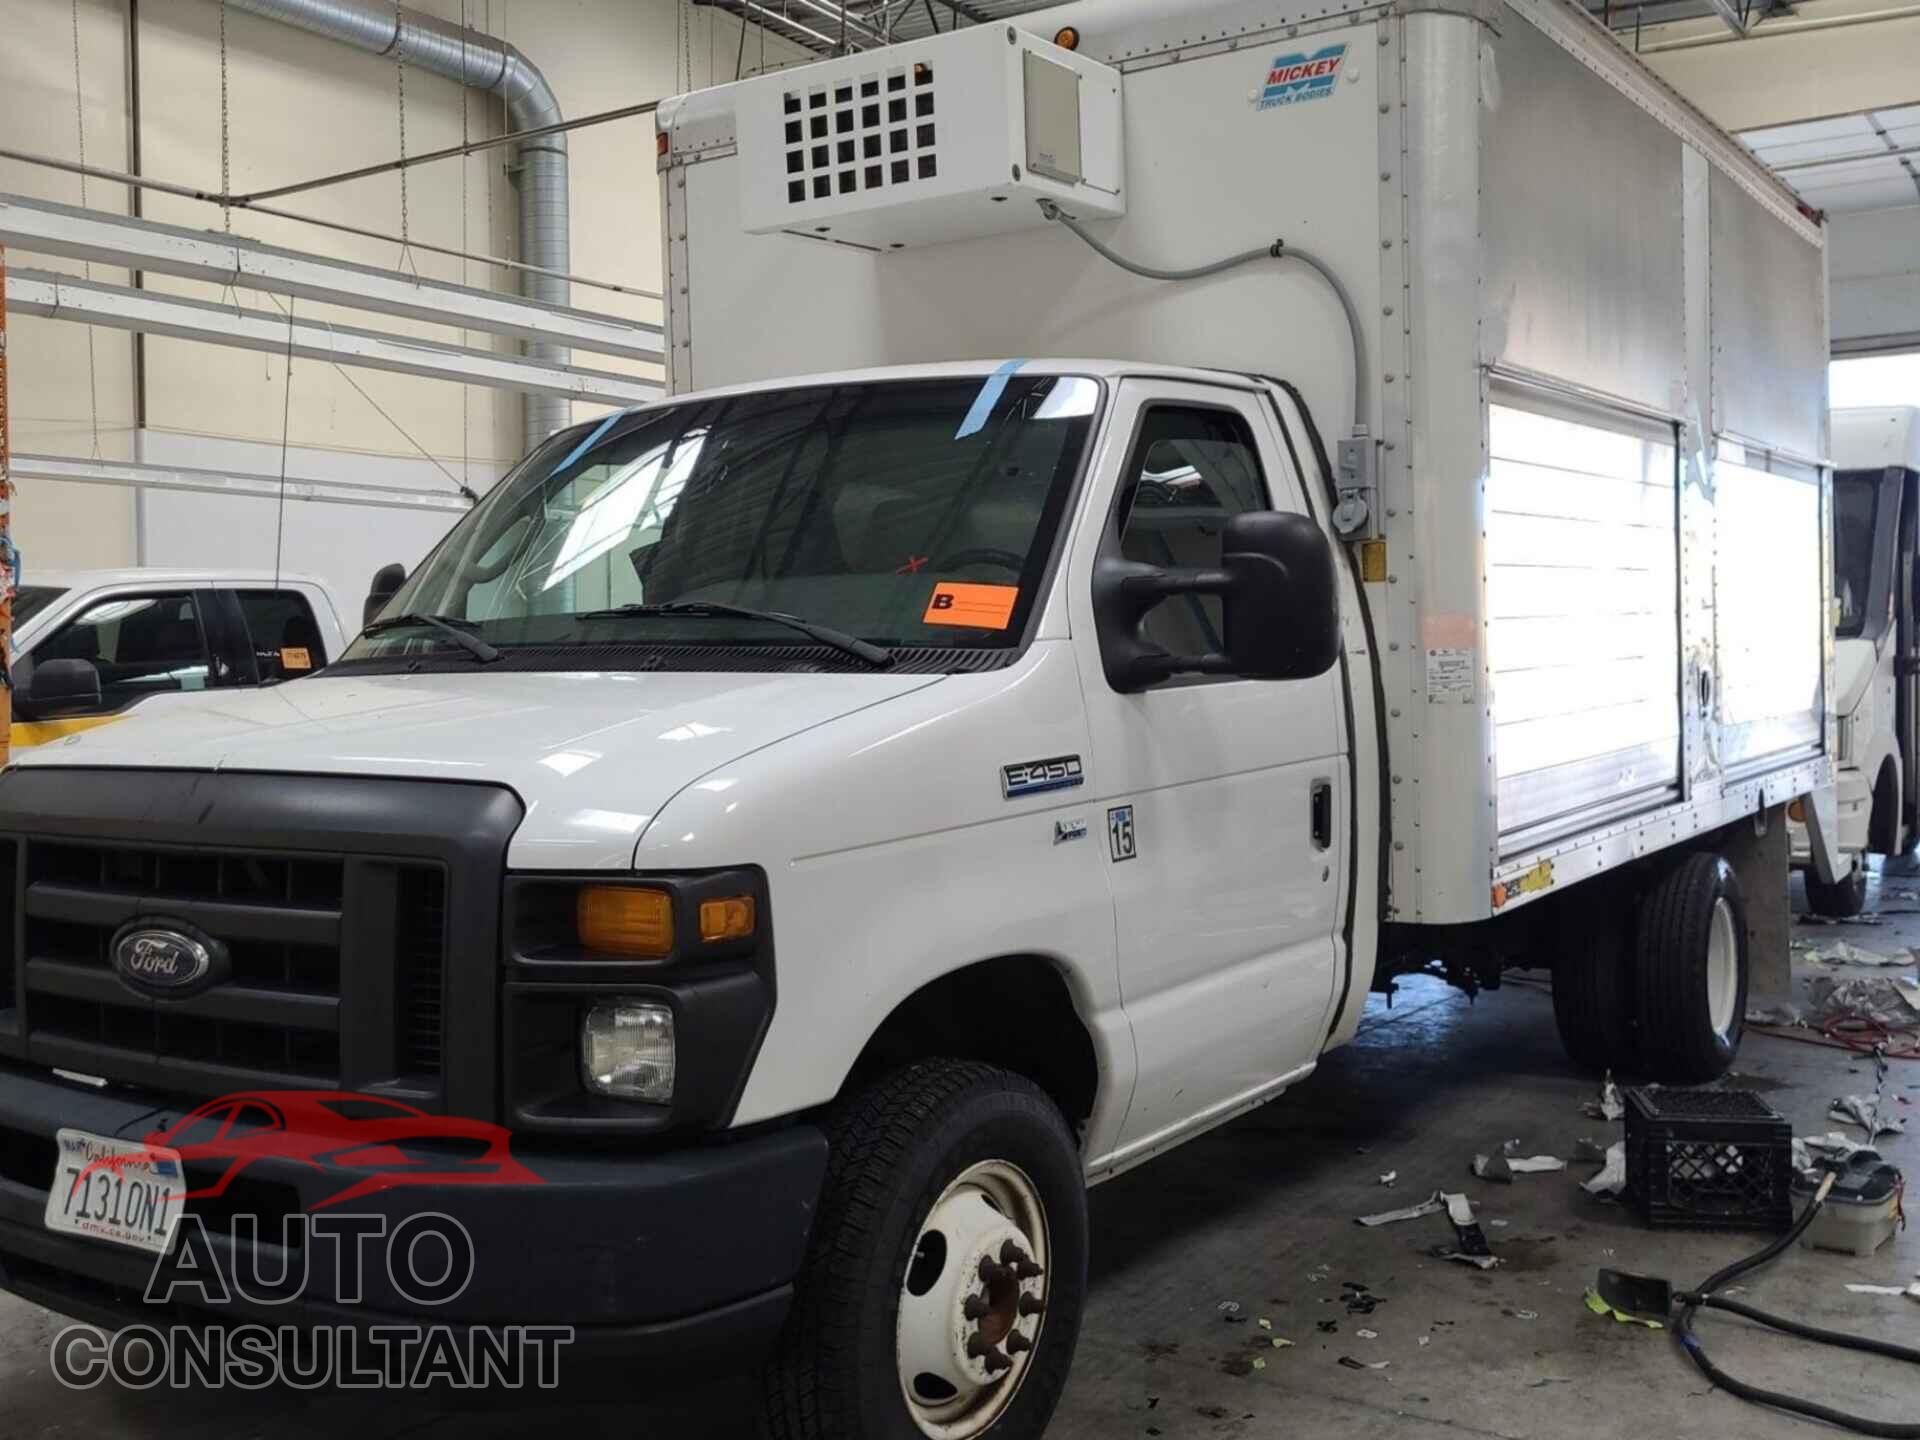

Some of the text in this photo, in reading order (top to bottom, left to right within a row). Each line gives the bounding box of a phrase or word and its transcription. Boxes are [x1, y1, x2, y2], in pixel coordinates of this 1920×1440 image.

[1267, 58, 1340, 85] MICKEY
[931, 593, 955, 609] B
[1112, 821, 1133, 855] 15
[130, 939, 179, 974] Ford
